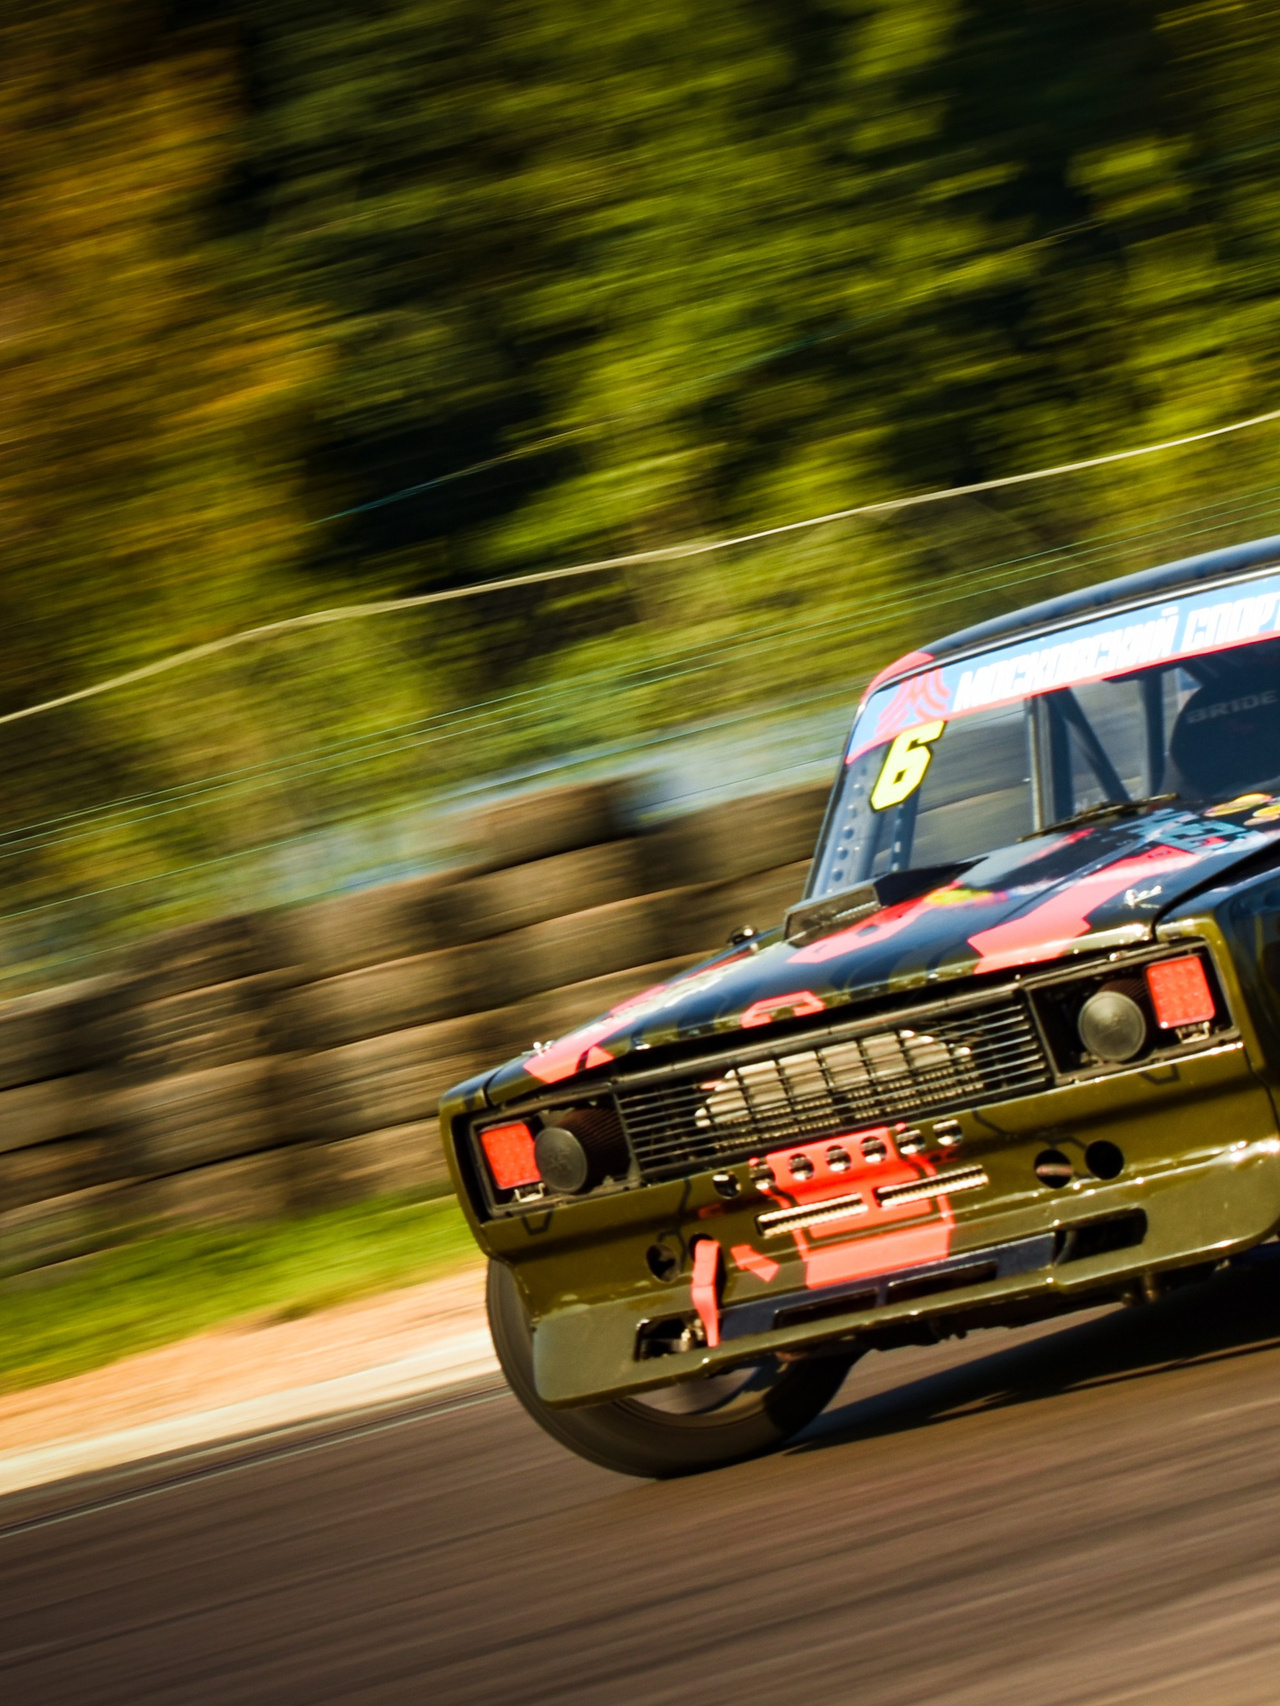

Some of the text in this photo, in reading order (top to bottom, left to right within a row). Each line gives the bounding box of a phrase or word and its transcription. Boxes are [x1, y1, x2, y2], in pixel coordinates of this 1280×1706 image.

[953, 607, 1178, 713] МОСКОВСКИЙ
[1186, 689, 1280, 725] BRIDE
[869, 720, 947, 814] 6
